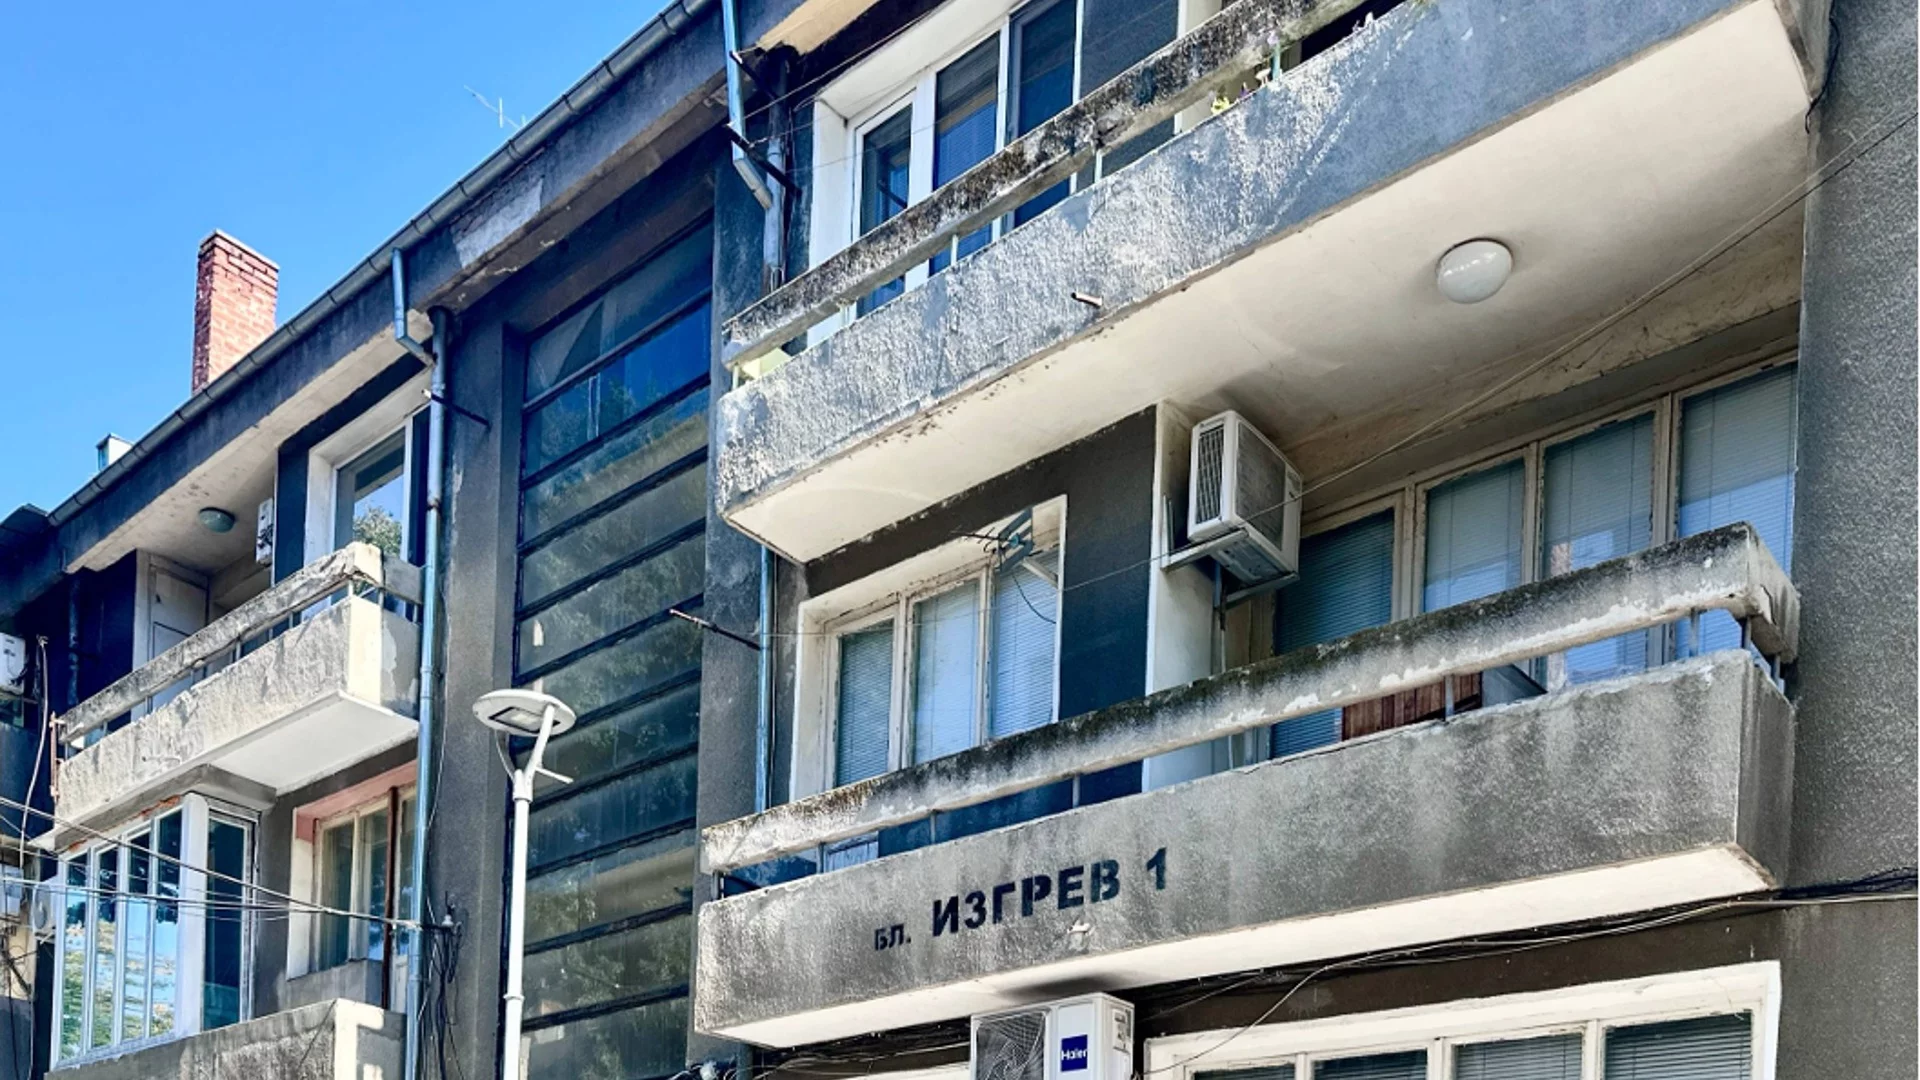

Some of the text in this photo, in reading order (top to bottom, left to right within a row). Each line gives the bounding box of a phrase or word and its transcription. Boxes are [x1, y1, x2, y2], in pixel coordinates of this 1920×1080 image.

[932, 859, 1120, 937] ИЗГРЕВ
[1146, 847, 1167, 890] 1
[1061, 1048, 1088, 1061] Haier
